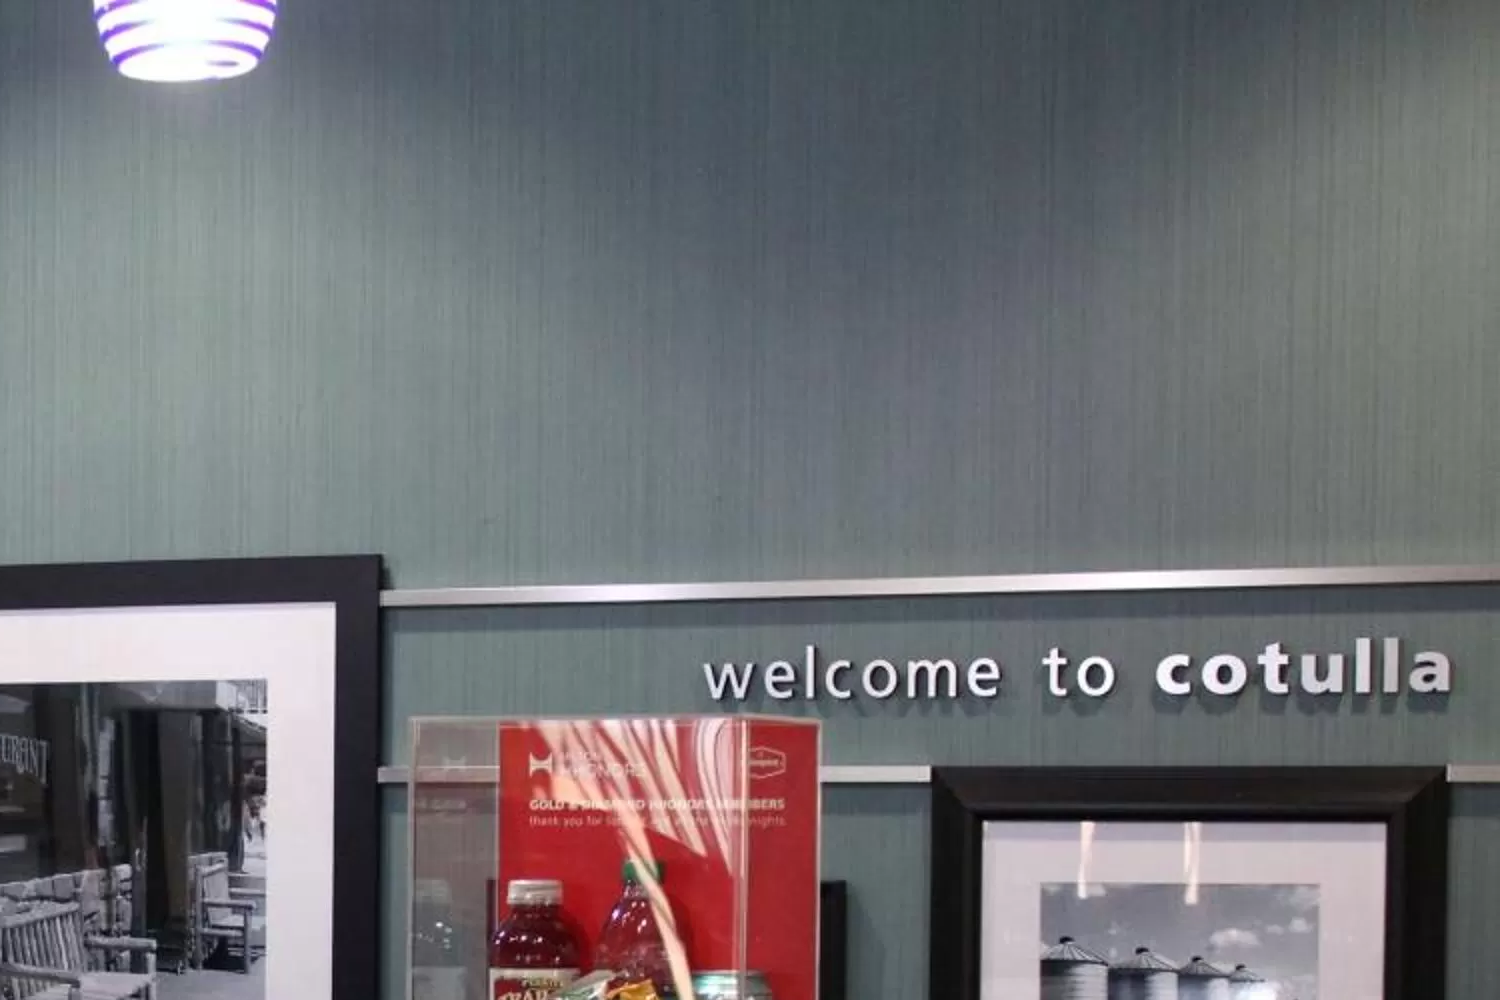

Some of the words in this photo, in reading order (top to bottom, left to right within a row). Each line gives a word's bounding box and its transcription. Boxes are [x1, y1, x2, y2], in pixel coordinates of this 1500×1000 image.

[703, 646, 1001, 701] welcome
[1042, 646, 1117, 697] to
[1155, 637, 1451, 696] cotulla
[529, 799, 565, 811] GOLD
